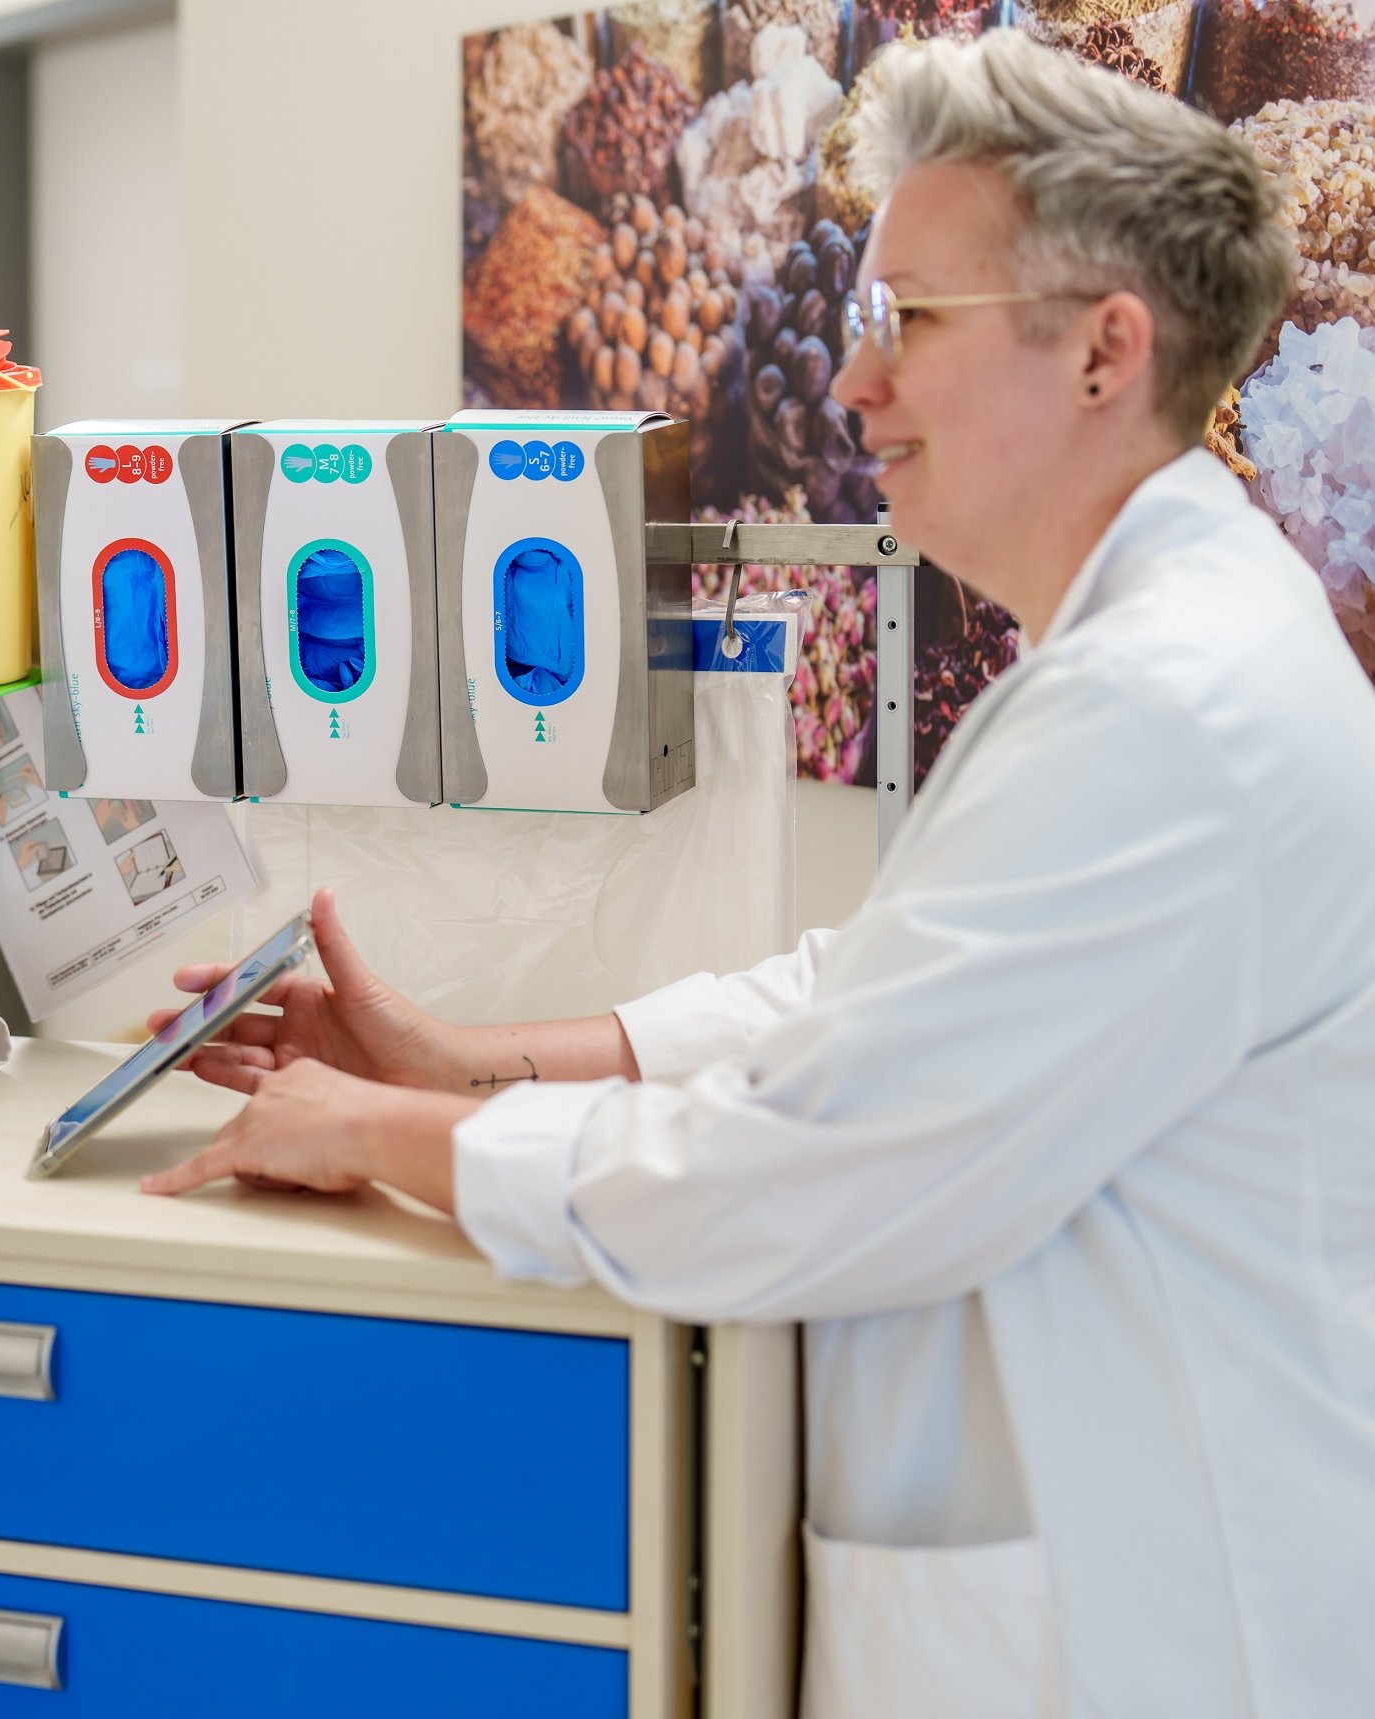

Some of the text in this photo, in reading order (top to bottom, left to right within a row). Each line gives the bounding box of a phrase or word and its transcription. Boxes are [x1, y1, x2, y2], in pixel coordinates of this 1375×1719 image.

[150, 451, 158, 479] powder-
[319, 458, 329, 470] M
[348, 450, 357, 479] powder-
[529, 457, 539, 465] S
[559, 446, 568, 477] powder-
[568, 454, 576, 469] free
[71, 673, 82, 717] sky-blue
